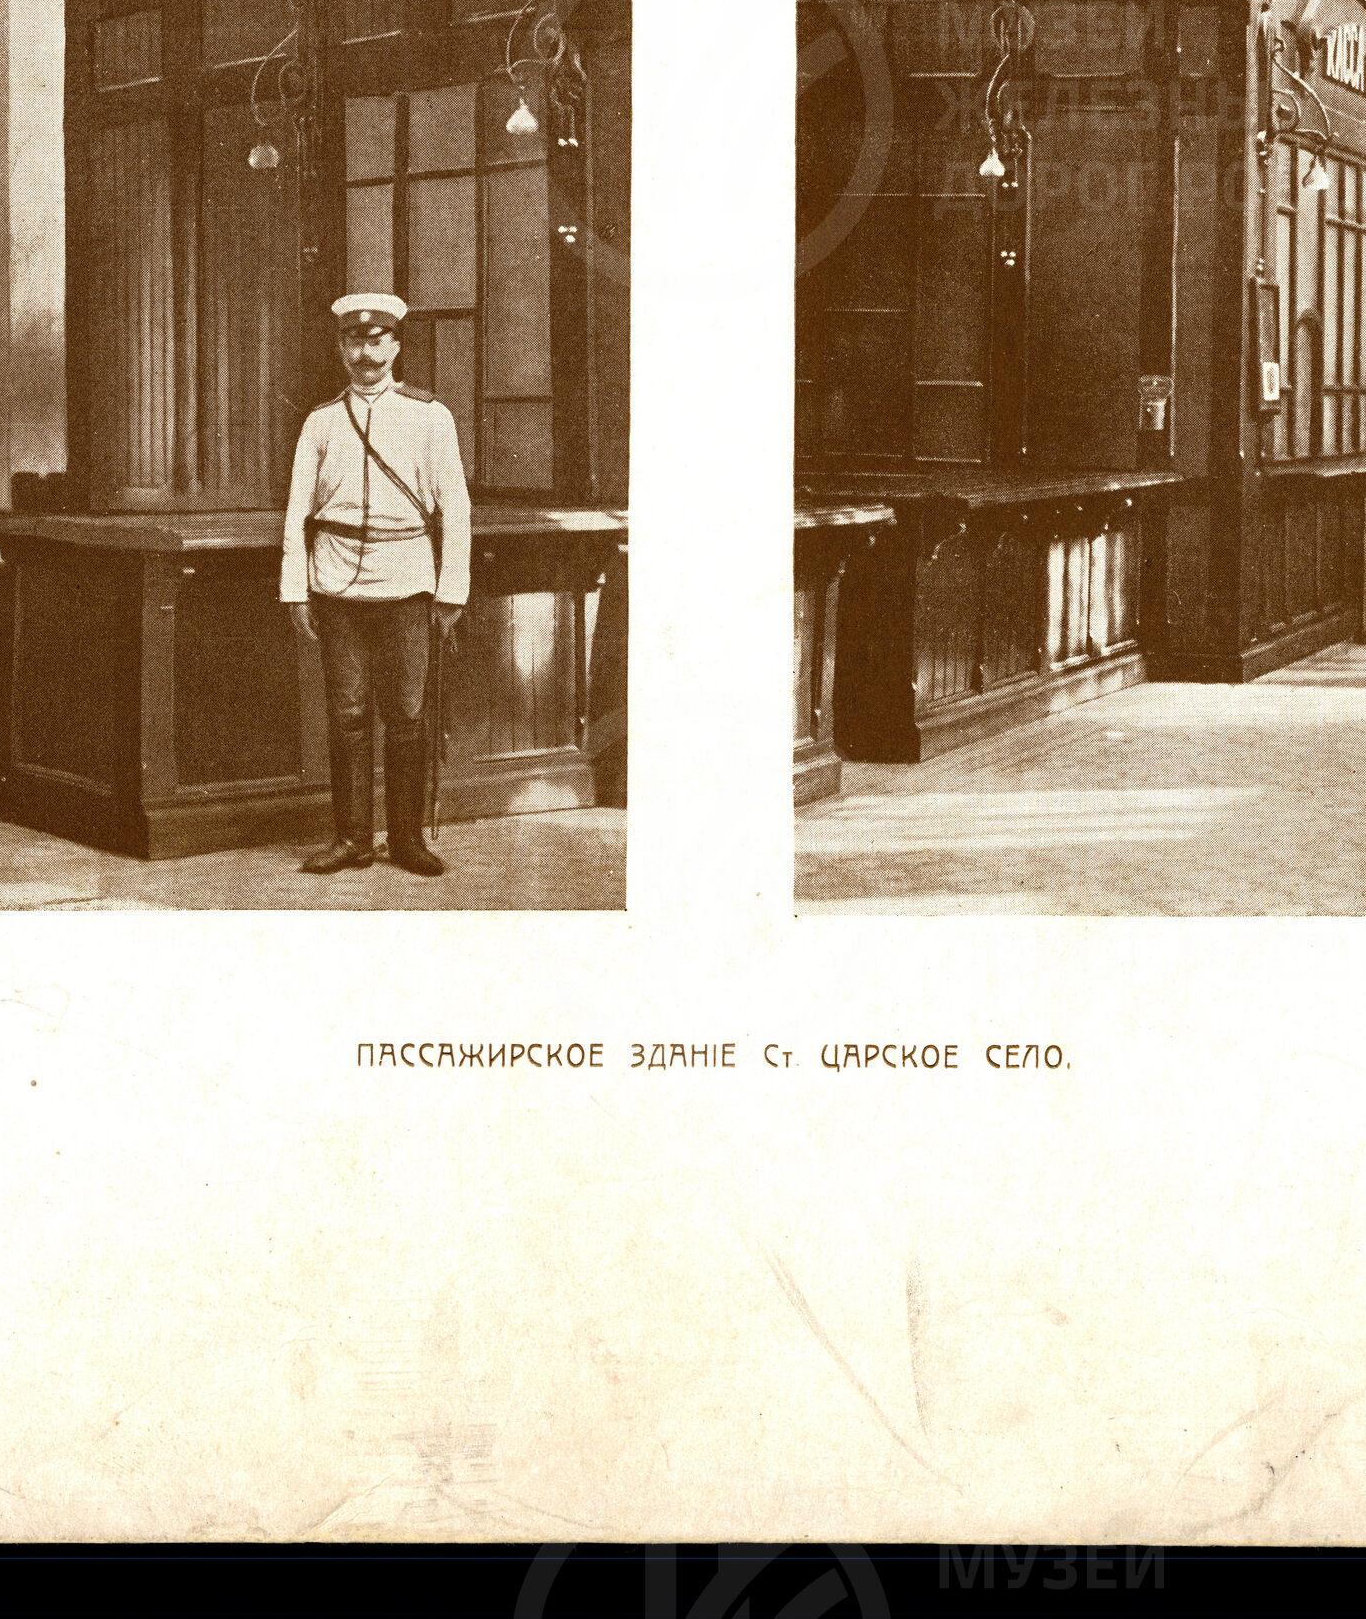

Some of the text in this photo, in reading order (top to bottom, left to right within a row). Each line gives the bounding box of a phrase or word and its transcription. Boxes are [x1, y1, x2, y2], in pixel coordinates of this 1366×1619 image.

[357, 1042, 603, 1069] ПАССАЖИРСКОЕ
[631, 1042, 736, 1070] ЗДАНІЕ
[820, 1043, 959, 1072] ЦАРСКОЕ
[985, 1044, 1071, 1070] СЕЛО.
